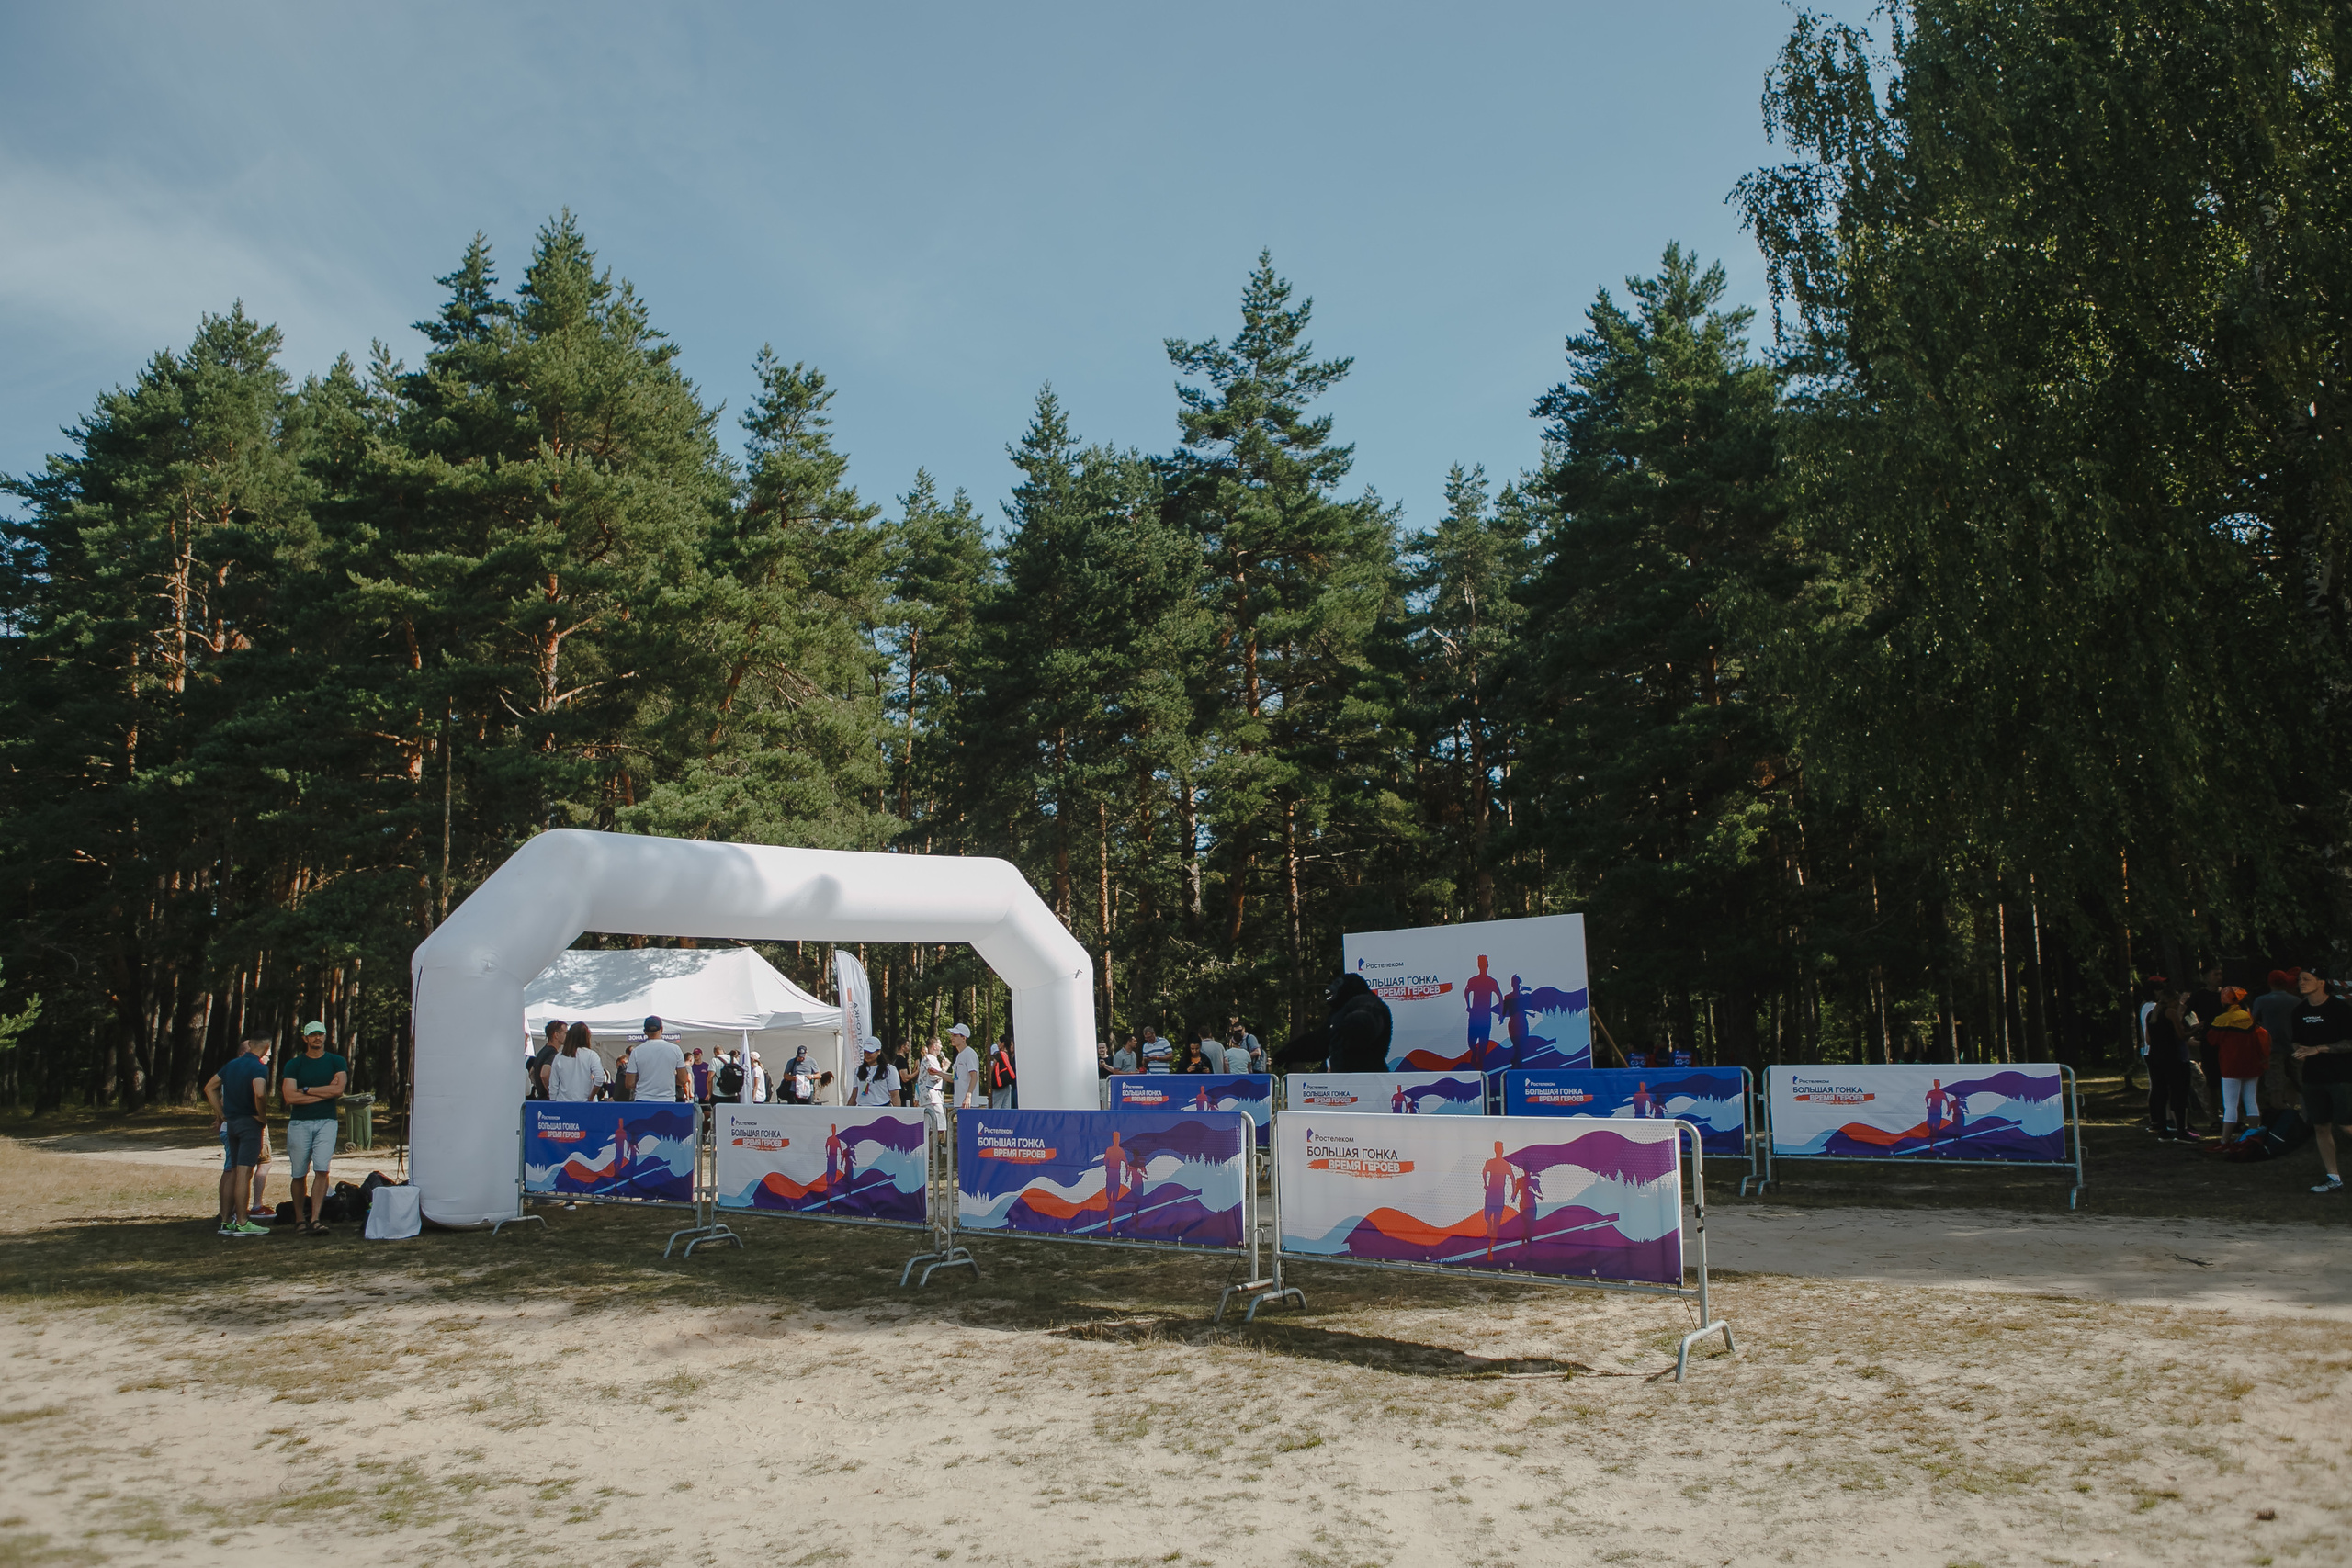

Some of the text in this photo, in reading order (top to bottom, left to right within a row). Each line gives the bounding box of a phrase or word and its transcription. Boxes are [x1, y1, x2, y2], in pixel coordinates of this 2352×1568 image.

[1365, 975, 1439, 987] ОЛЬШАЯ ГОНКА
[1377, 985, 1441, 997] ВРЕМЯ ГЕРОЕВ
[731, 1129, 781, 1138] БОЛЬШАЯ ГОНКА
[1315, 1134, 1354, 1143] Ростелеком
[762, 1139, 783, 1147] ГЕРОЕВ
[978, 1137, 1046, 1148] БОЛЬШАЯ ГОНКА
[993, 1149, 1046, 1159] ВРЕМЯ ГЕРОЕВ
[1306, 1146, 1398, 1160] БОЛЬШАЯ ГОНКА
[1328, 1159, 1401, 1173] ВРЕМЯ ГЕРОЕВ
